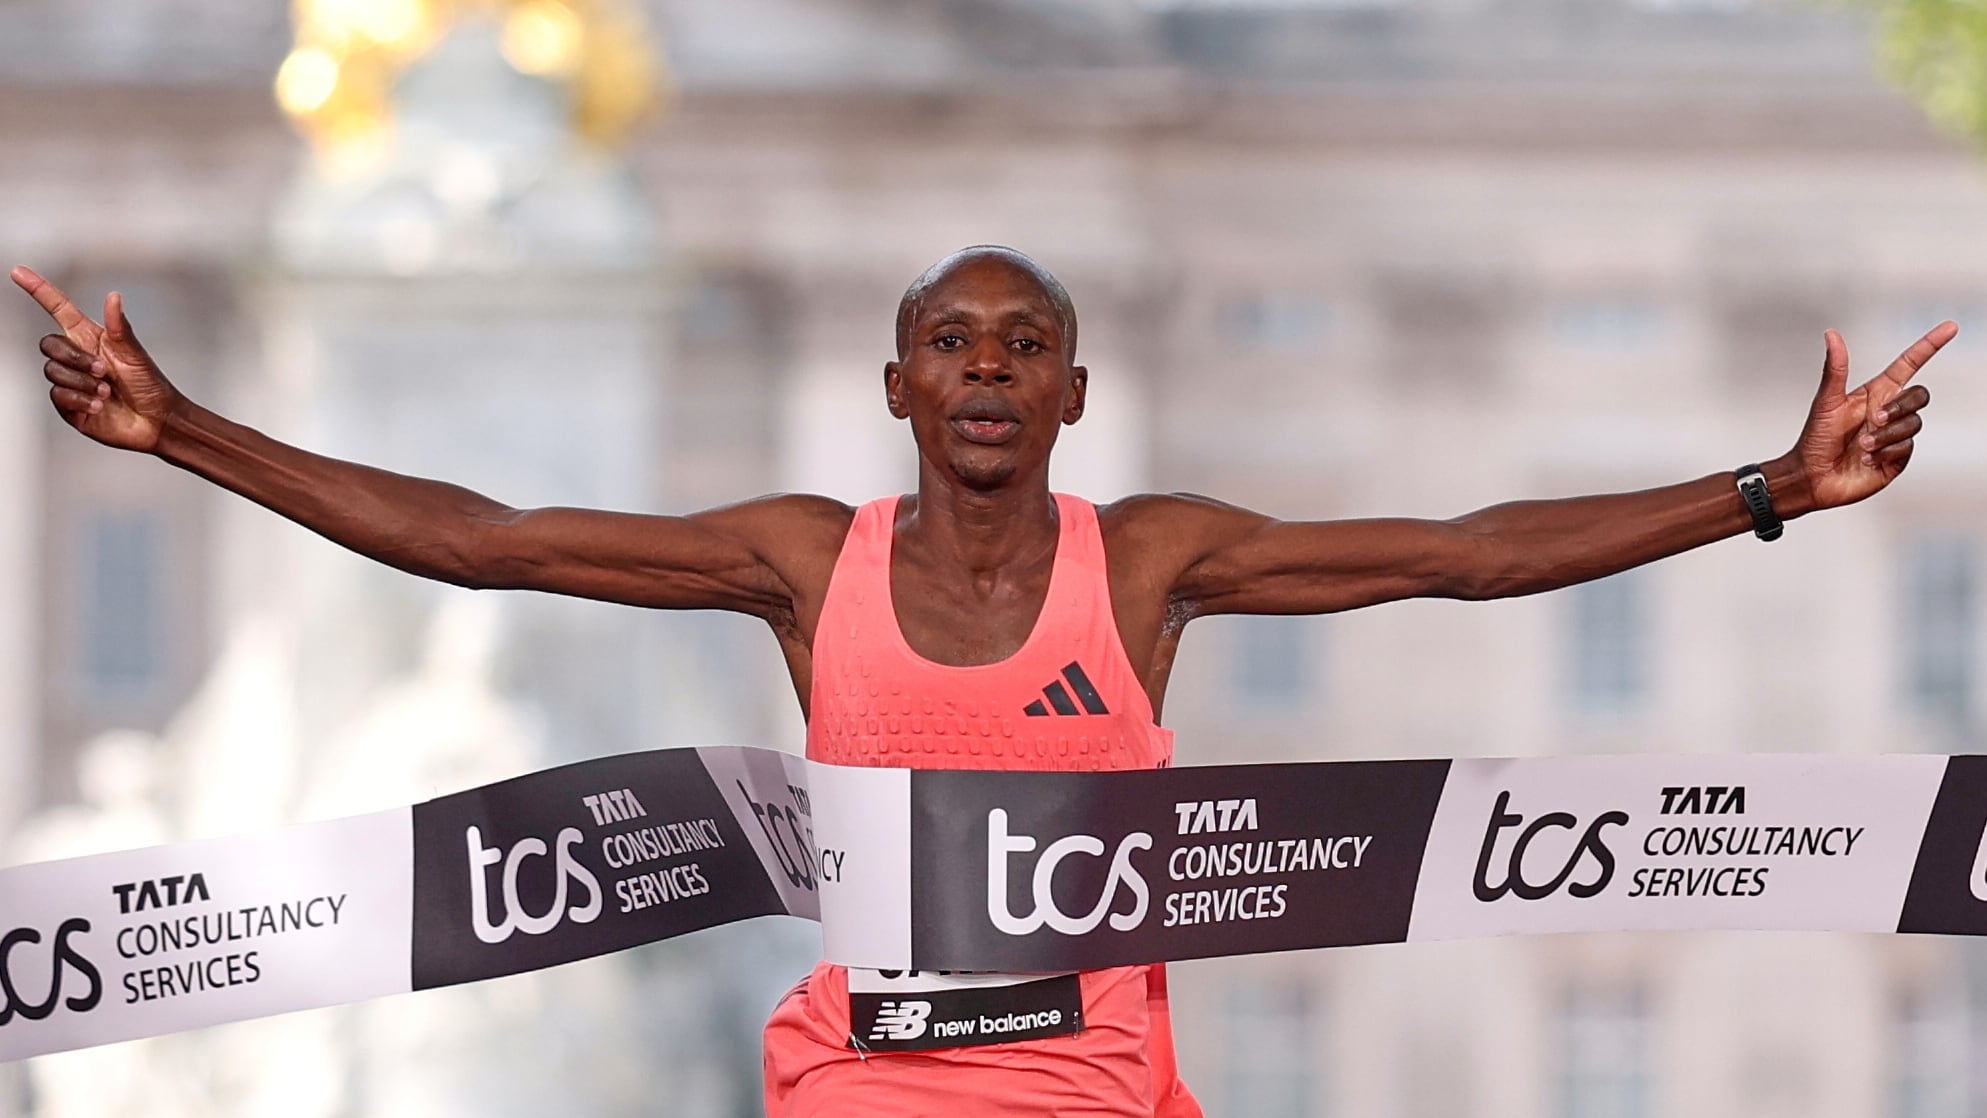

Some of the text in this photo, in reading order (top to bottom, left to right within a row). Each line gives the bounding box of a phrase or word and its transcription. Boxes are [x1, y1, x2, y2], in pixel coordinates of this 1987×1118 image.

[583, 788, 647, 826] TATA
[1175, 799, 1258, 835] TATA
[1660, 786, 1746, 815] TATA
[602, 819, 726, 869] CONSULTANCY
[1168, 836, 1373, 882] CONSULTANCY
[1473, 790, 1630, 902] tcs
[1643, 827, 1864, 856] CONSULTANCY
[113, 873, 210, 914] TATA
[466, 825, 602, 944] tcs
[615, 863, 710, 913] SERVICES
[988, 808, 1153, 936] tcs
[1628, 867, 1769, 897] SERVICES
[116, 894, 347, 959] CONSULTANCY
[1163, 884, 1288, 928] SERVICES
[0, 918, 102, 1026] cs
[123, 952, 261, 1004] SERVICES
[933, 1021, 976, 1038] new
[979, 1009, 1062, 1034] balance
